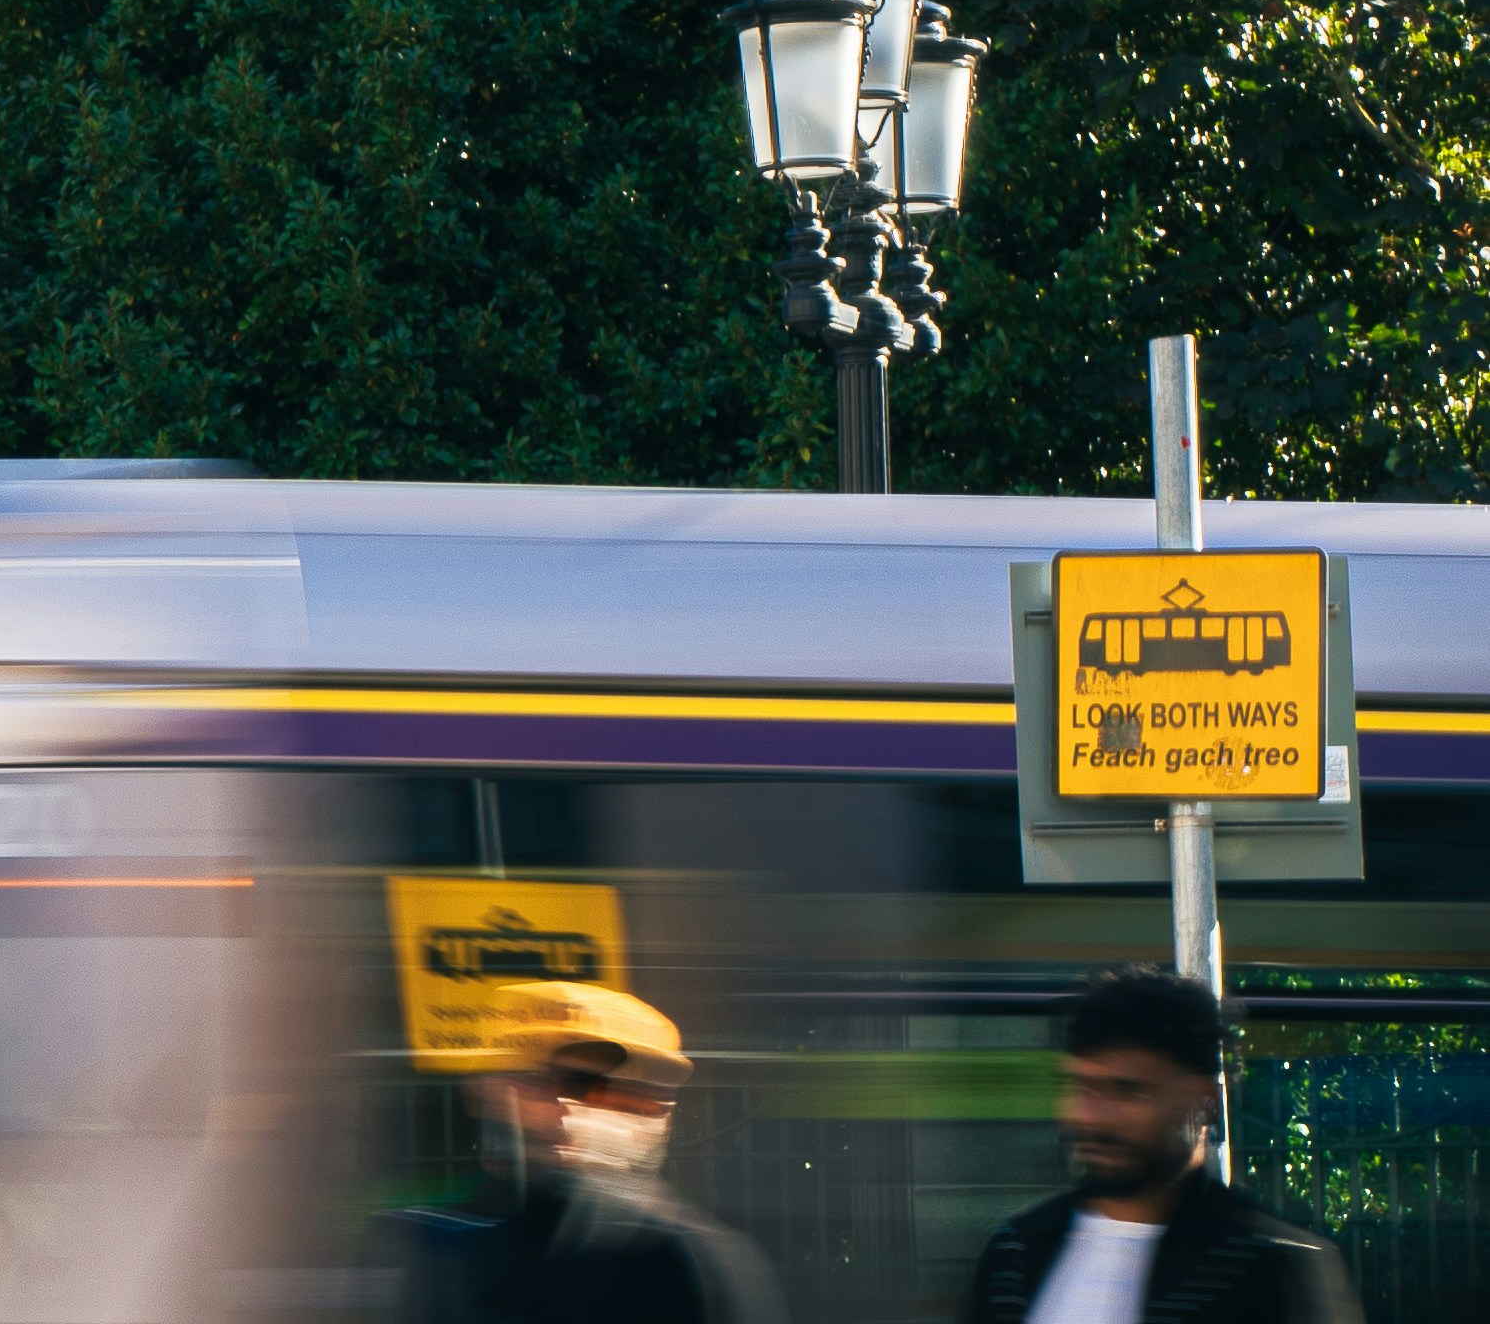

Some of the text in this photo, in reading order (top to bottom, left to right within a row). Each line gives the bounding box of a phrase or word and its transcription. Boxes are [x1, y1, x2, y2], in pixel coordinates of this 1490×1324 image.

[1072, 701, 1299, 728] LOOK BOTH WAYS
[1165, 742, 1233, 774] gach
[1243, 742, 1299, 766] treo
